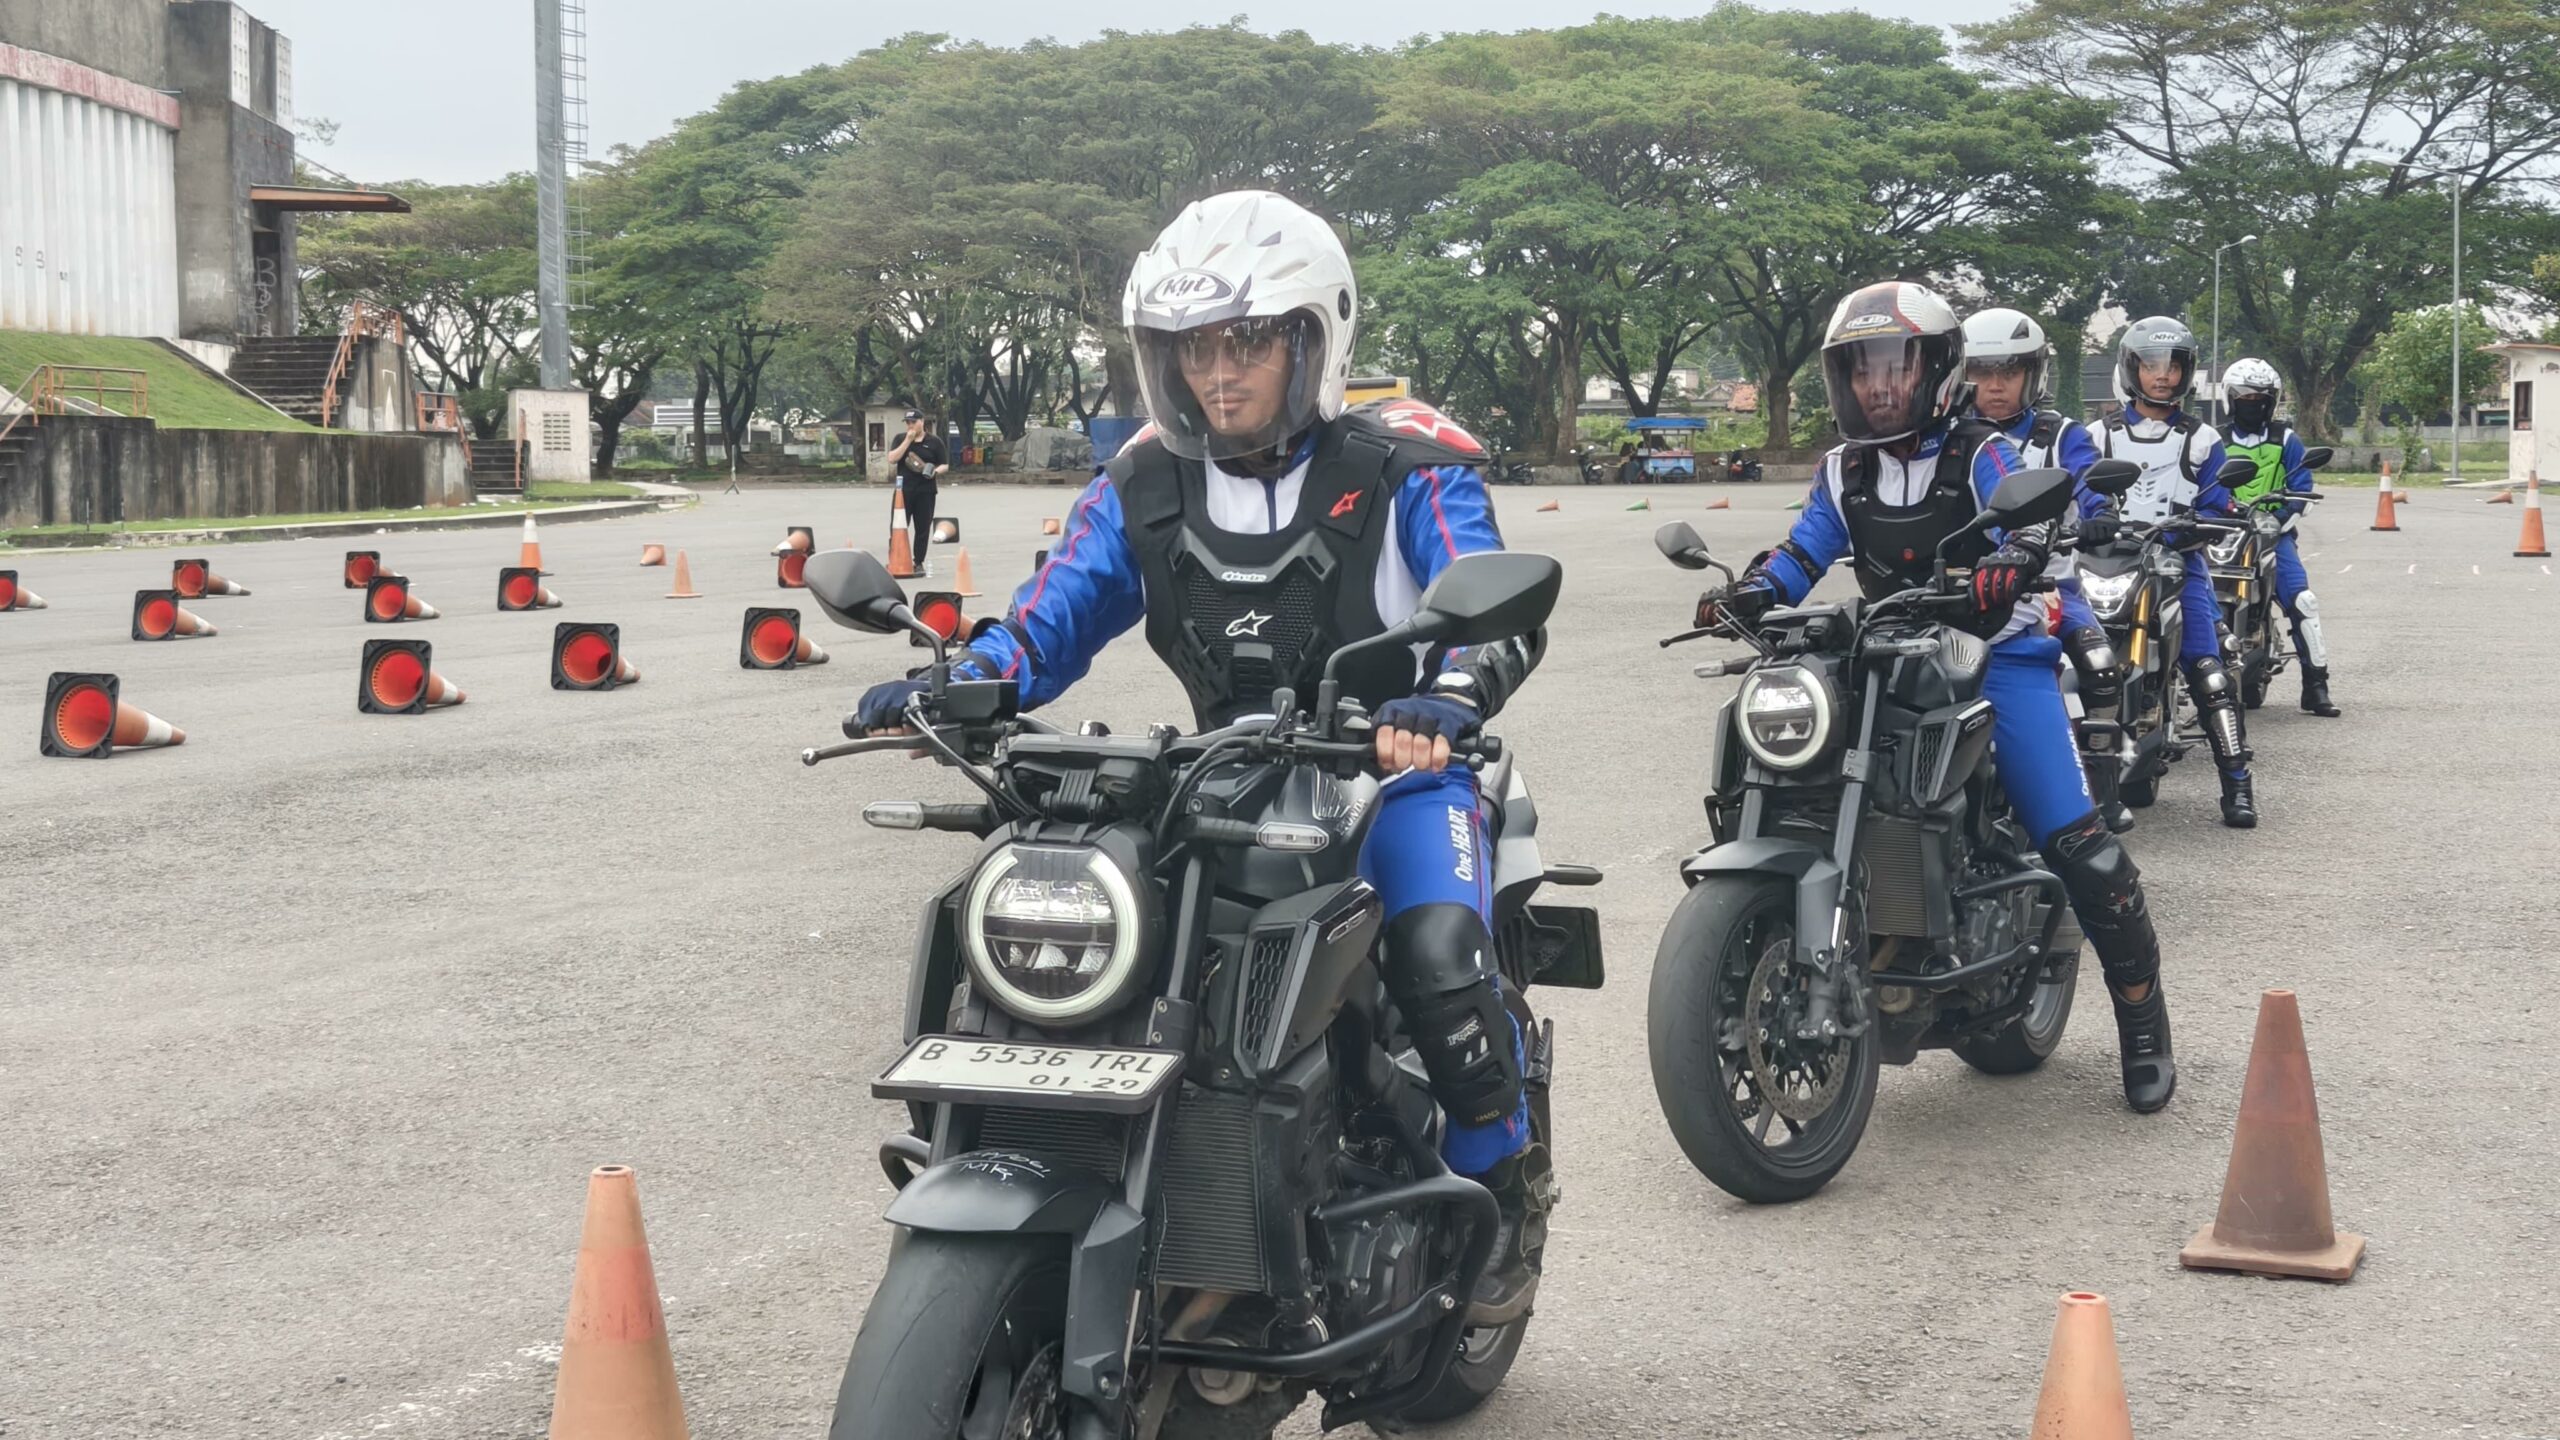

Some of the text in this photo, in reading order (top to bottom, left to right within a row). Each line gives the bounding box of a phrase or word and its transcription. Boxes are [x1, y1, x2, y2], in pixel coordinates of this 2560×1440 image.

[1454, 852, 1473, 882] One
[919, 1043, 1152, 1073] B 5536 TRL
